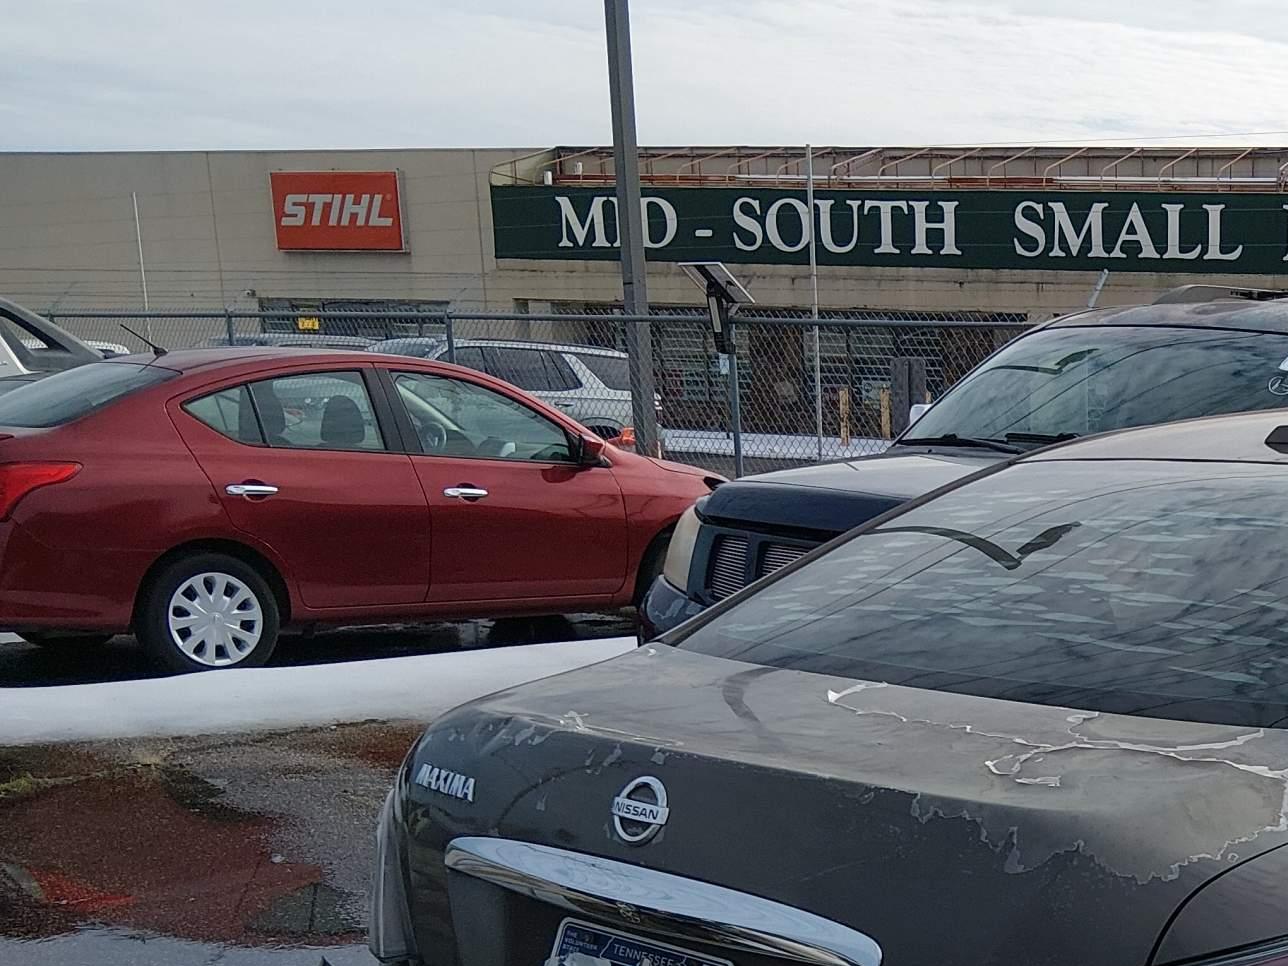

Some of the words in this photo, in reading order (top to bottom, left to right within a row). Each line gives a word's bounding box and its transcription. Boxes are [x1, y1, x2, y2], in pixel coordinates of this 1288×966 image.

[281, 193, 393, 227] STIHL
[694, 229, 713, 237] -
[732, 197, 963, 256] SOUTH
[1013, 200, 1244, 261] SMALL
[415, 763, 476, 803] MAXIMA
[614, 801, 659, 821] NISSAN
